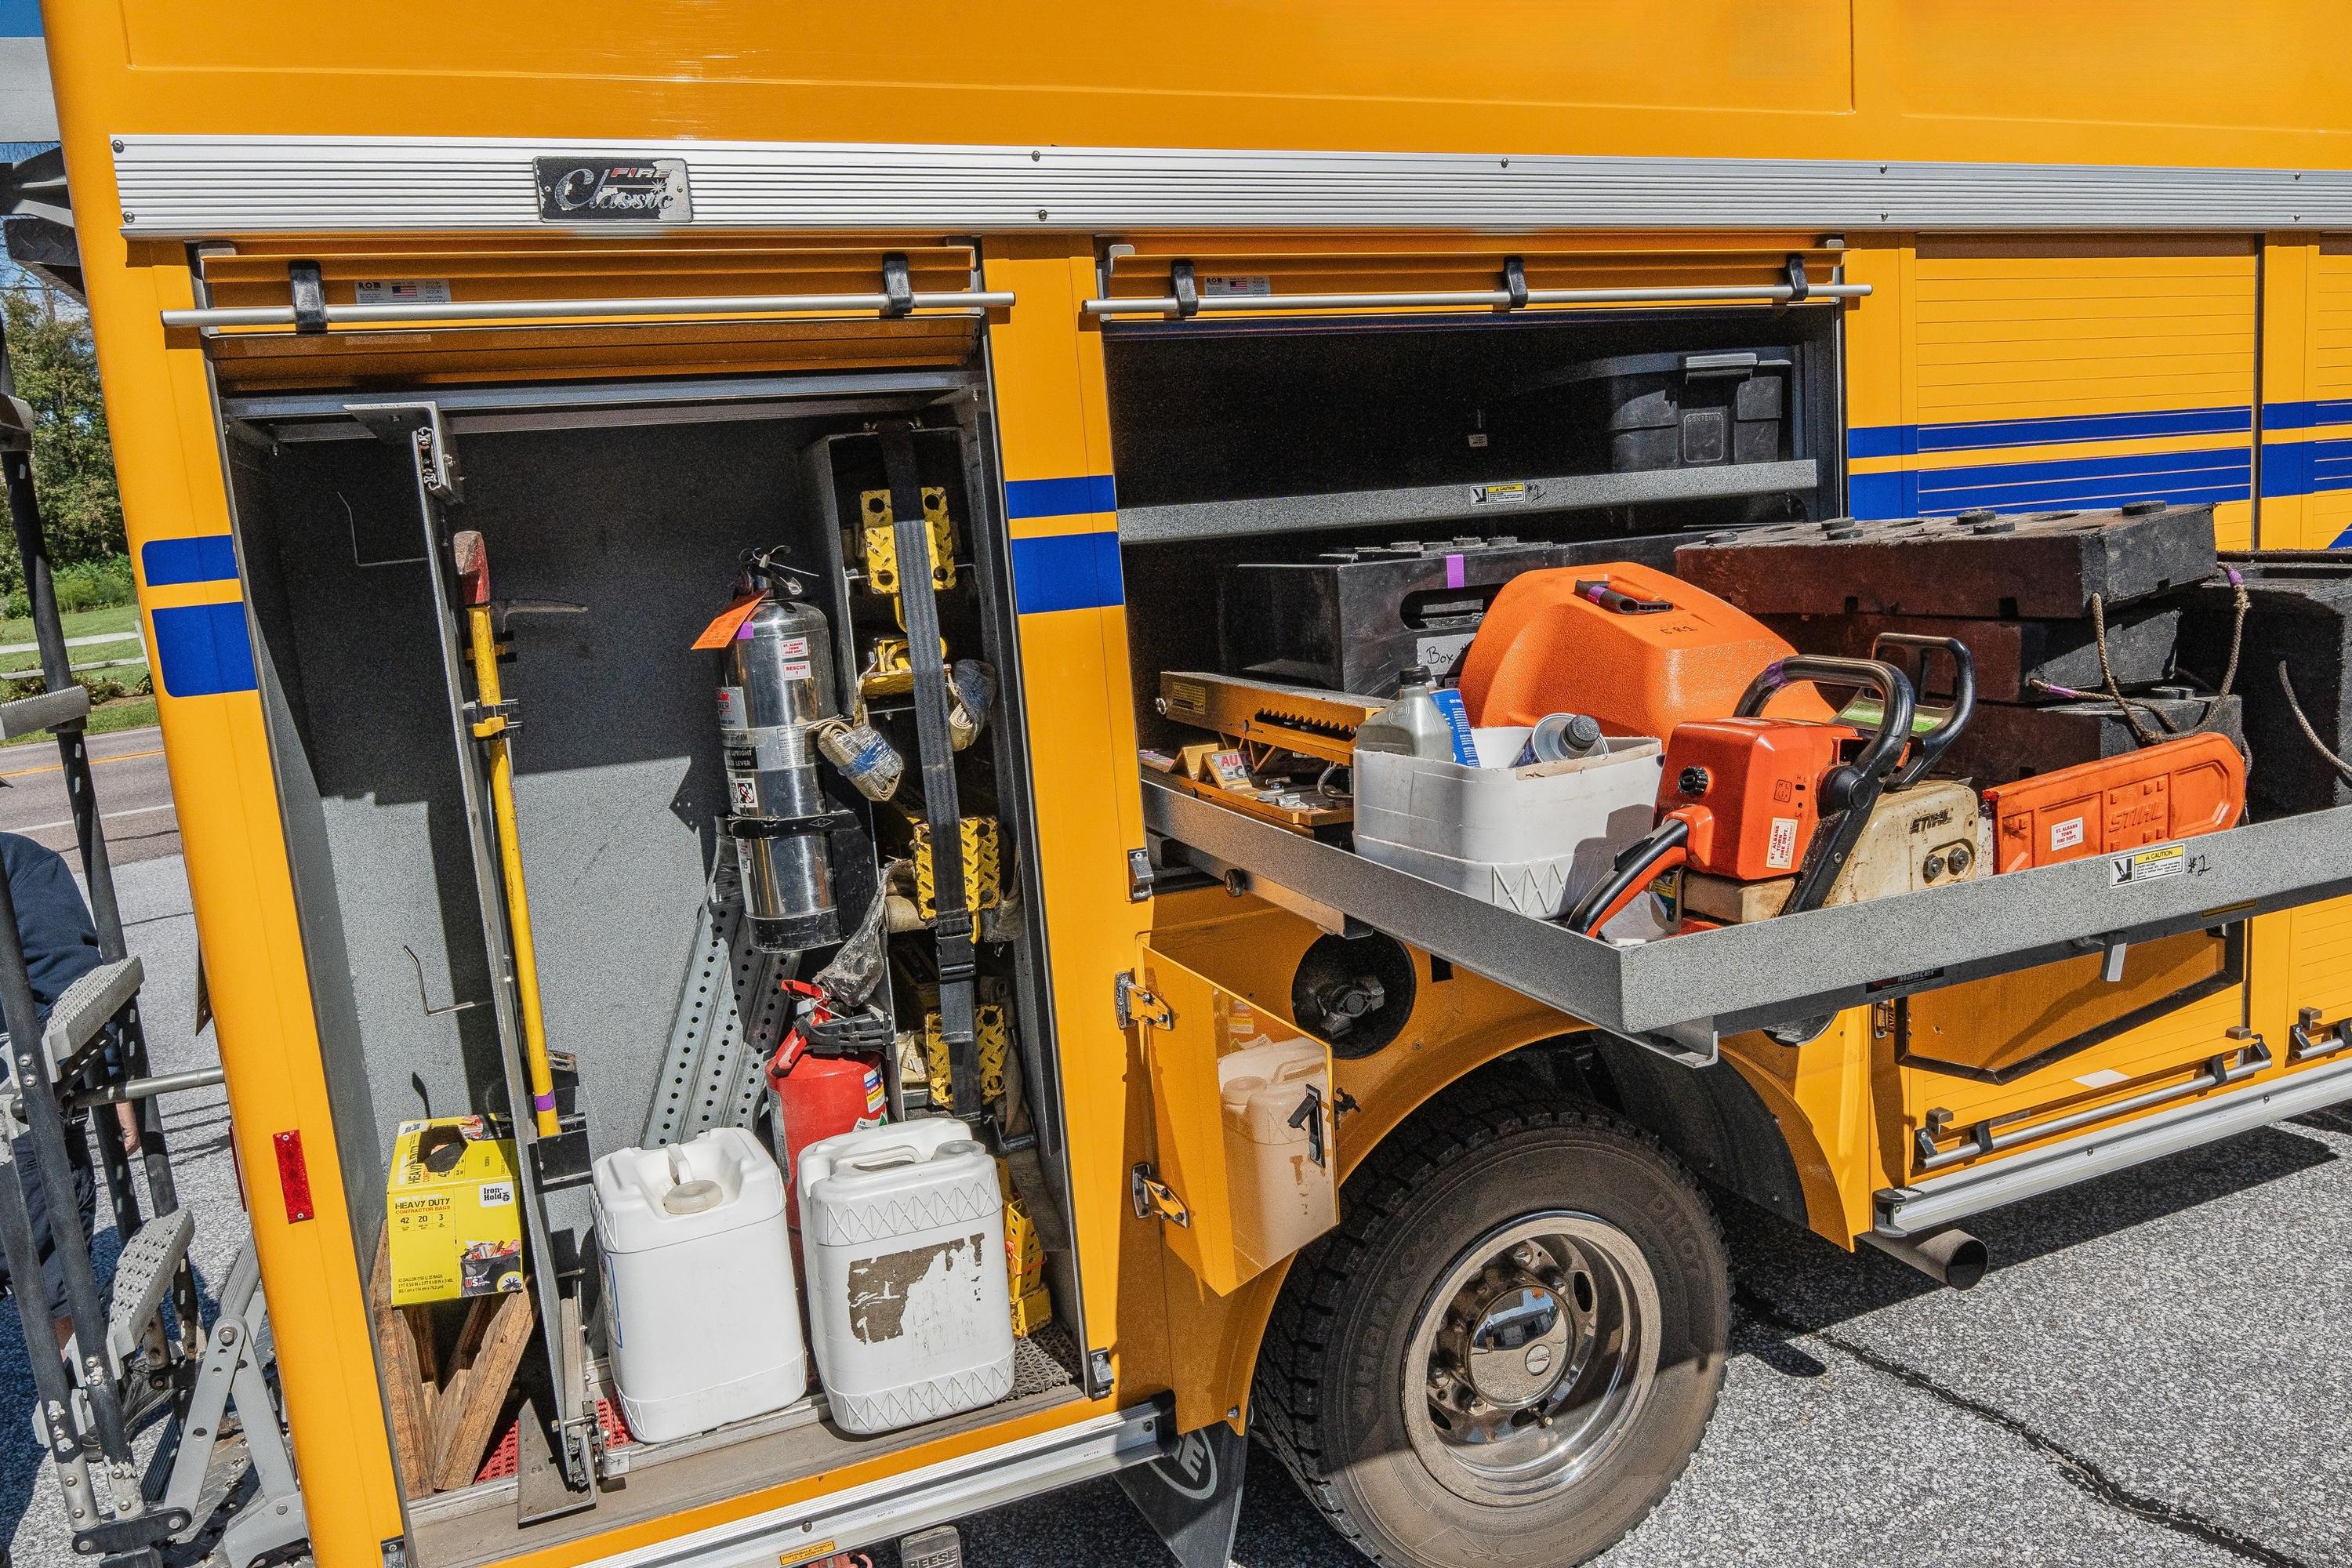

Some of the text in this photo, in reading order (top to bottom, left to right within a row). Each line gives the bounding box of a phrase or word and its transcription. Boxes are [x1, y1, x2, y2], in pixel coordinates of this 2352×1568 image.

[611, 167, 673, 178] FIRE
[554, 169, 674, 211] Classic
[1425, 646, 1454, 665] Box
[2108, 802, 2164, 833] STIHL
[2151, 850, 2173, 859] CAUTION
[395, 1200, 426, 1210] HEAVY
[428, 1198, 451, 1207] DUTY
[484, 1192, 502, 1201] Hold
[906, 1548, 958, 1568] REESE
